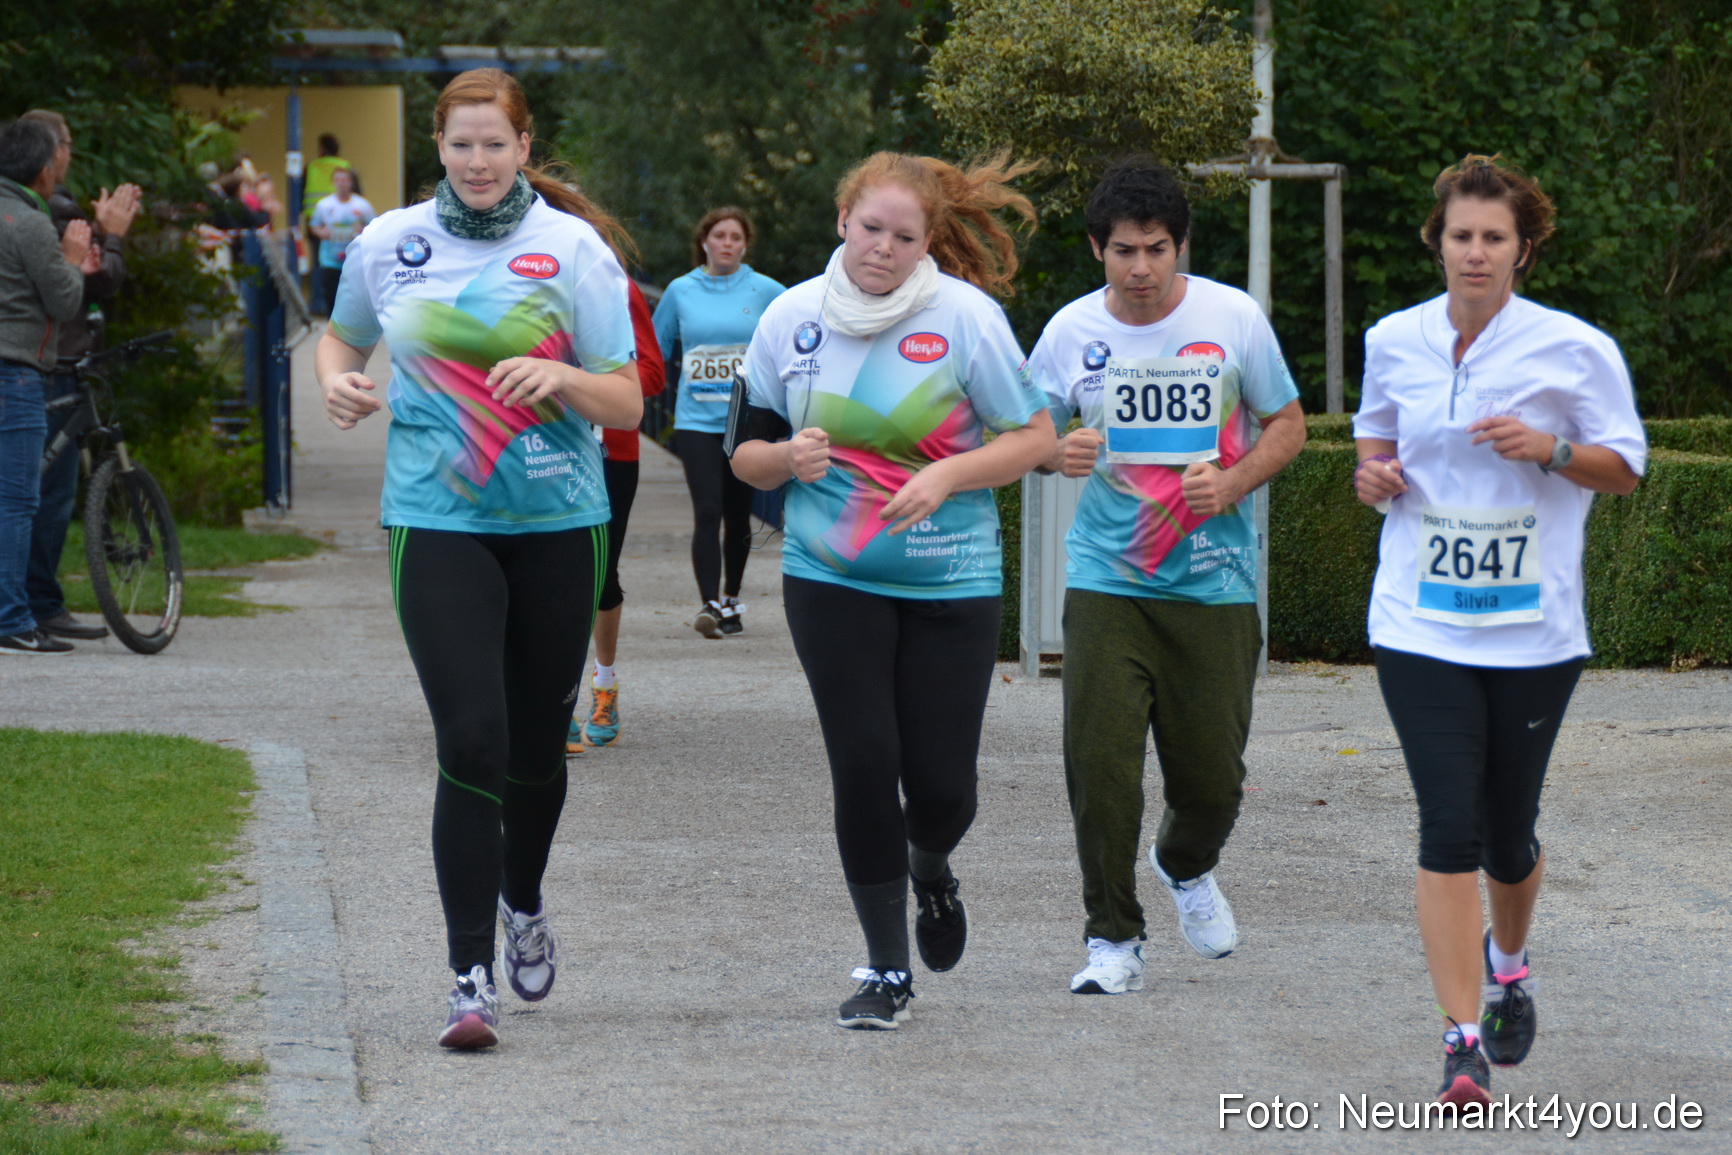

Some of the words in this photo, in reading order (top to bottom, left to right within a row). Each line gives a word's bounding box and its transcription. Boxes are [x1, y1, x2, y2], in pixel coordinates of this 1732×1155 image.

[514, 258, 555, 273] Hervis
[905, 340, 944, 356] Hervis
[1108, 367, 1143, 379] PARTL
[1146, 368, 1202, 378] Neumarkt
[1116, 383, 1212, 422] 3083
[520, 433, 549, 452] 16.
[525, 451, 578, 465] Neumarkte
[527, 463, 572, 478] Stadtlauf
[1423, 514, 1456, 529] PARTL
[1459, 518, 1518, 531] Neumarkt
[906, 532, 970, 544] Neumarkter
[1190, 531, 1211, 550] 16.
[905, 544, 958, 558] Stadtlauf
[1428, 533, 1529, 580] 2647
[1453, 591, 1499, 609] Silvia
